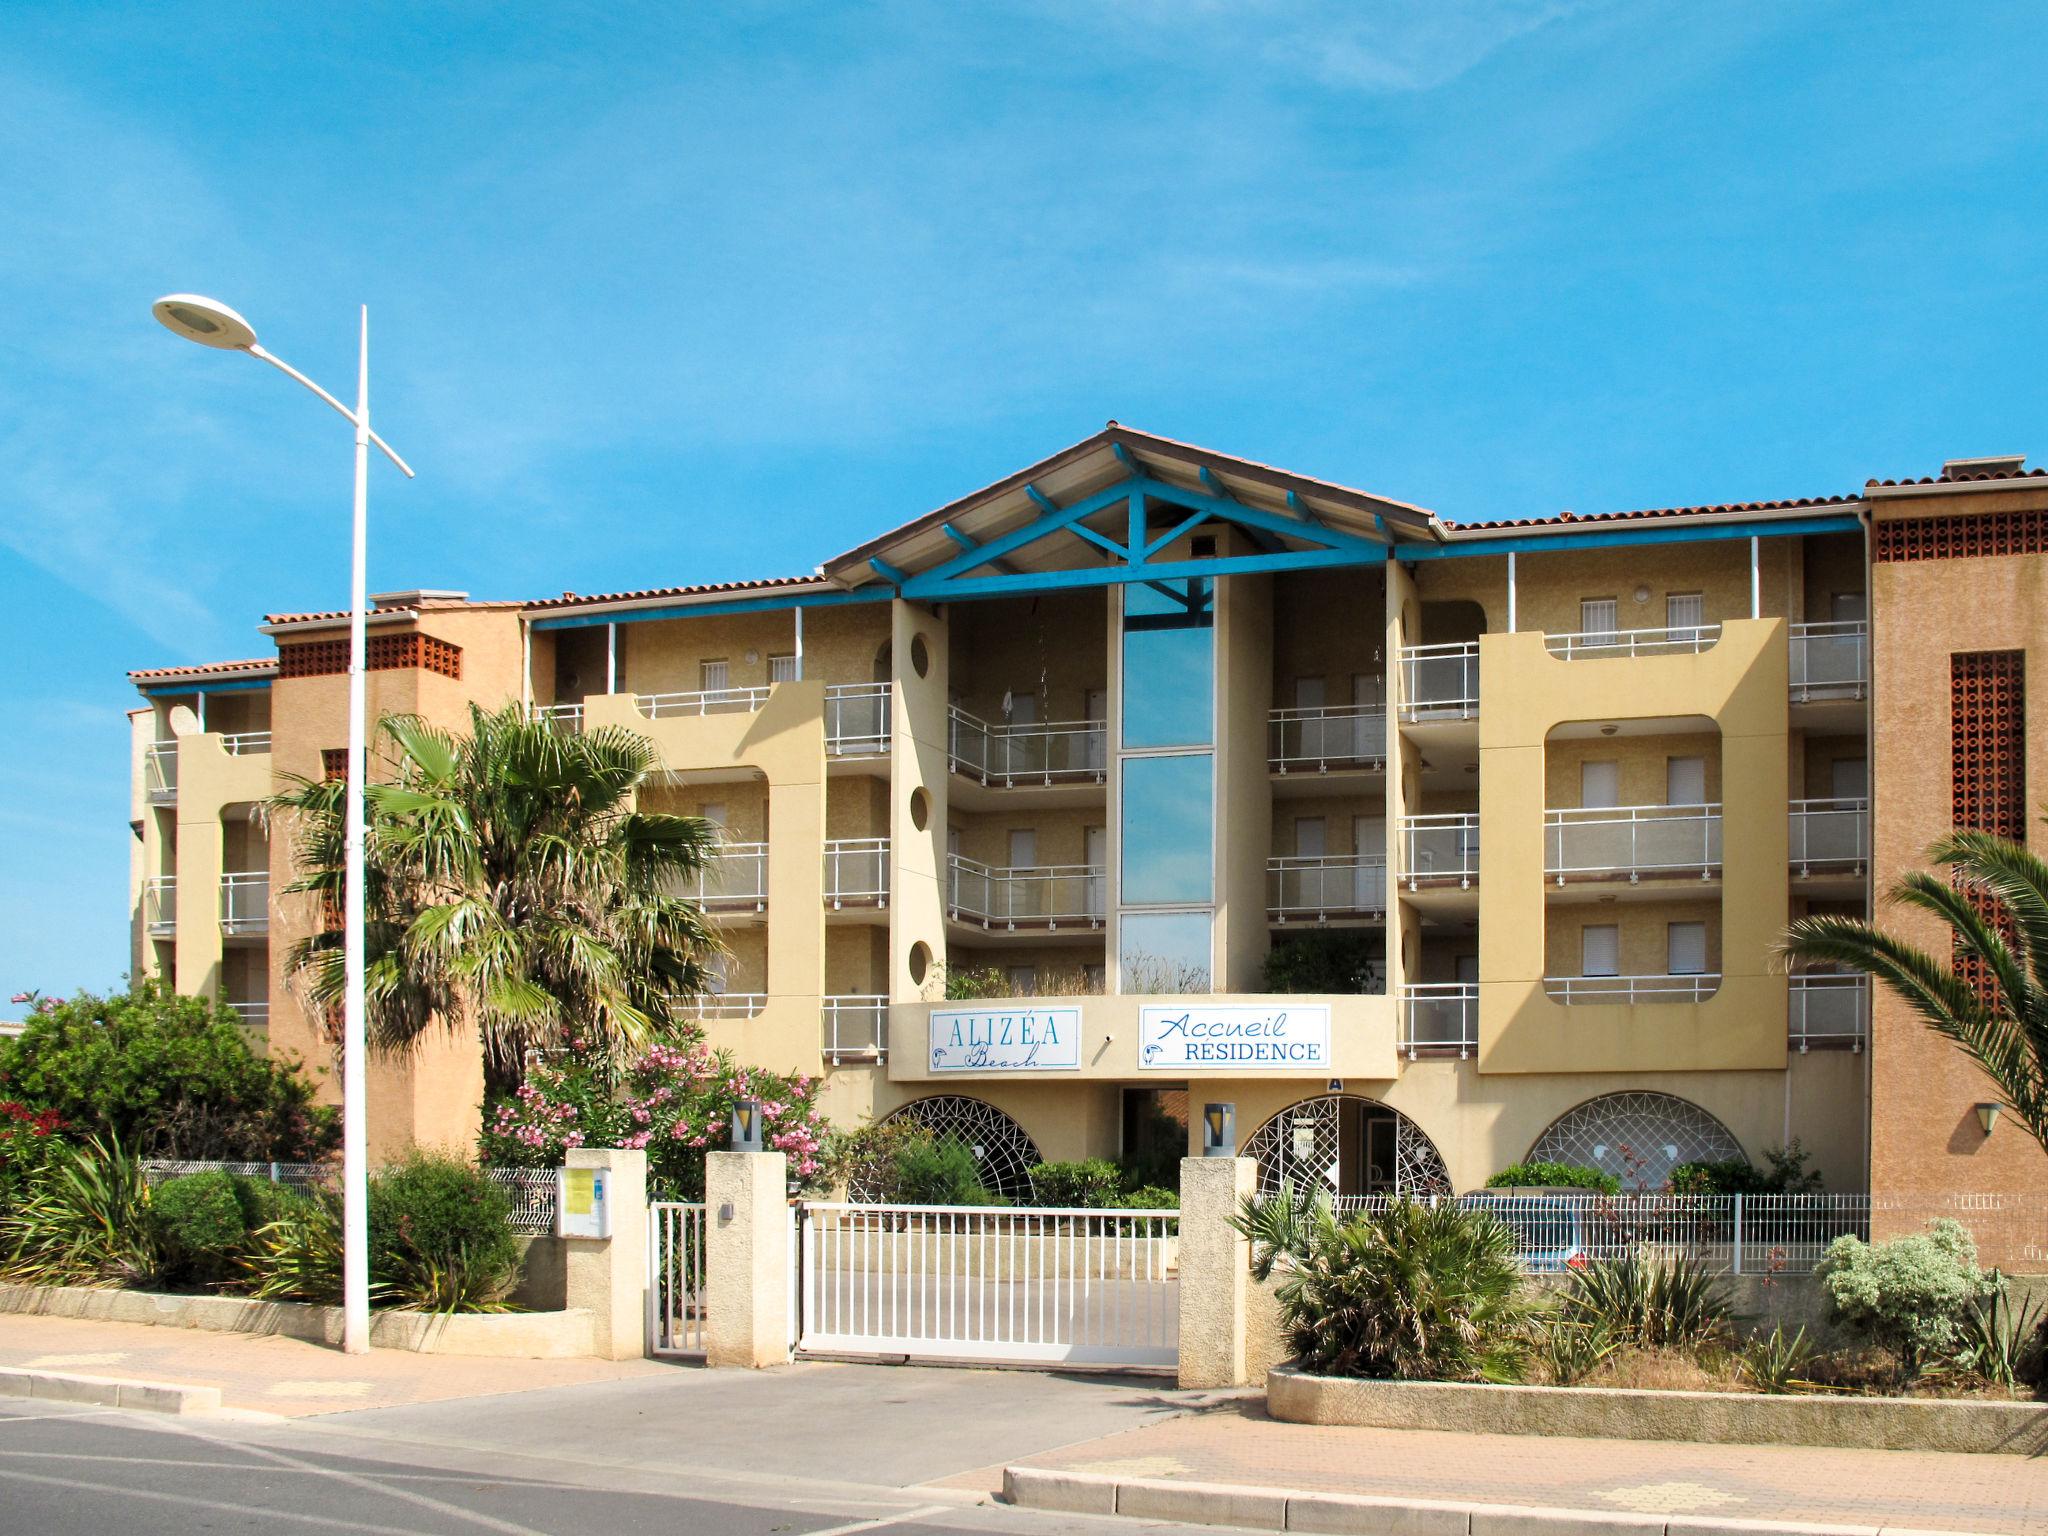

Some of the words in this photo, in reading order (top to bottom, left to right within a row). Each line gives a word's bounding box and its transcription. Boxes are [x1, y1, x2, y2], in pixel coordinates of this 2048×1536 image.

[949, 1010, 1059, 1046] ALIZÉA
[1158, 1013, 1287, 1040] Accueil
[965, 1041, 1039, 1067] Beach
[1185, 1038, 1321, 1061] RÉSIDENCE
